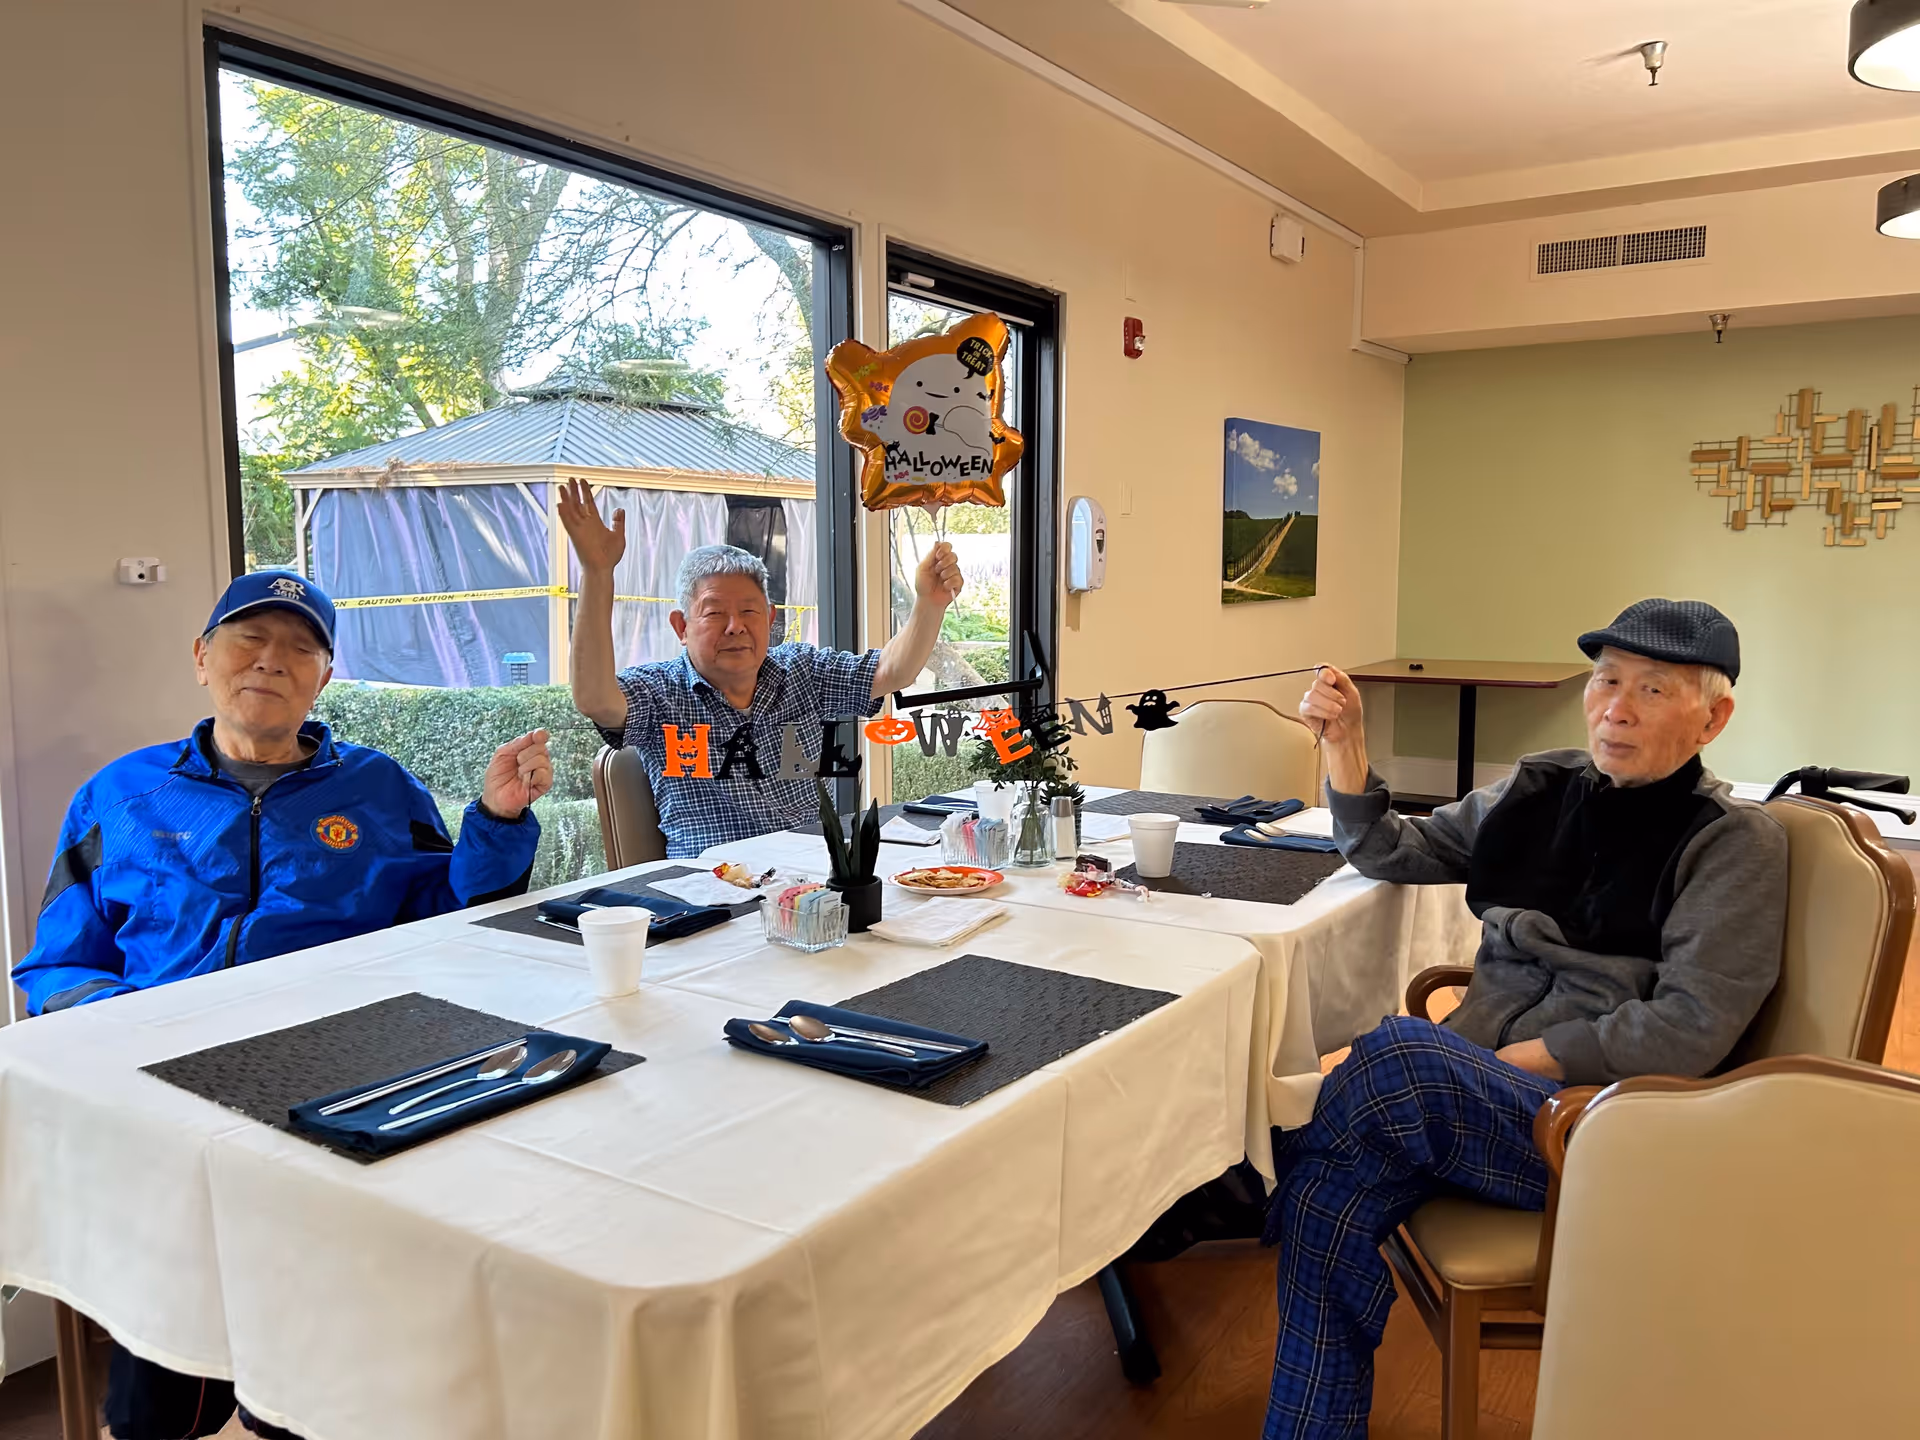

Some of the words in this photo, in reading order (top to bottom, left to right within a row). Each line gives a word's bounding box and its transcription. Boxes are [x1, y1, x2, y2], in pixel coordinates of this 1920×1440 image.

[970, 339, 993, 359] TRICK
[961, 351, 986, 372] TREAT
[884, 450, 994, 476] HALLOWEEN
[357, 597, 403, 606] CAUTION
[412, 594, 455, 603] CAUTION
